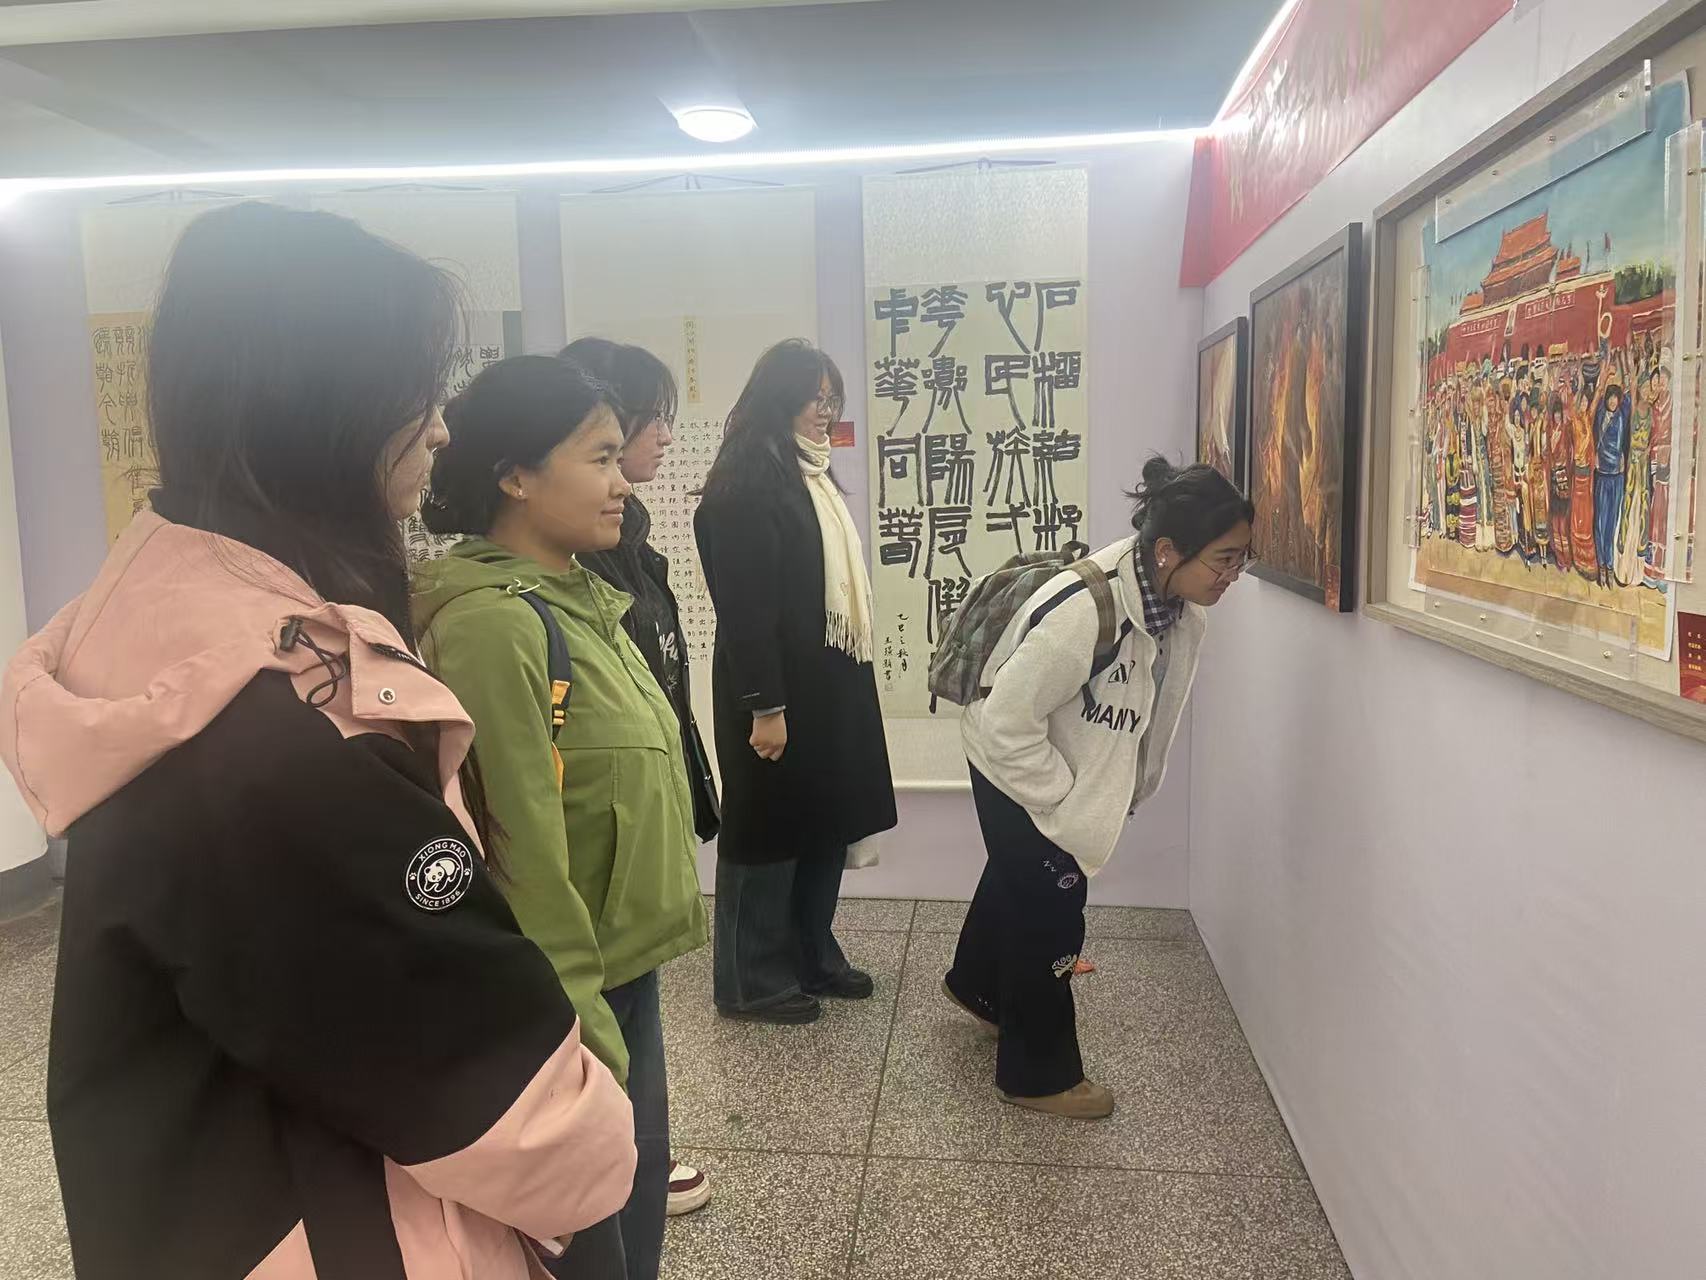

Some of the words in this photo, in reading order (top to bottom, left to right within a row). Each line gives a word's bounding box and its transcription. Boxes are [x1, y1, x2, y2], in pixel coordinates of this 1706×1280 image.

[1081, 703, 1141, 733] MANY
[418, 842, 448, 861] XIONG
[449, 842, 467, 858] MAO
[415, 893, 440, 907] SINCE
